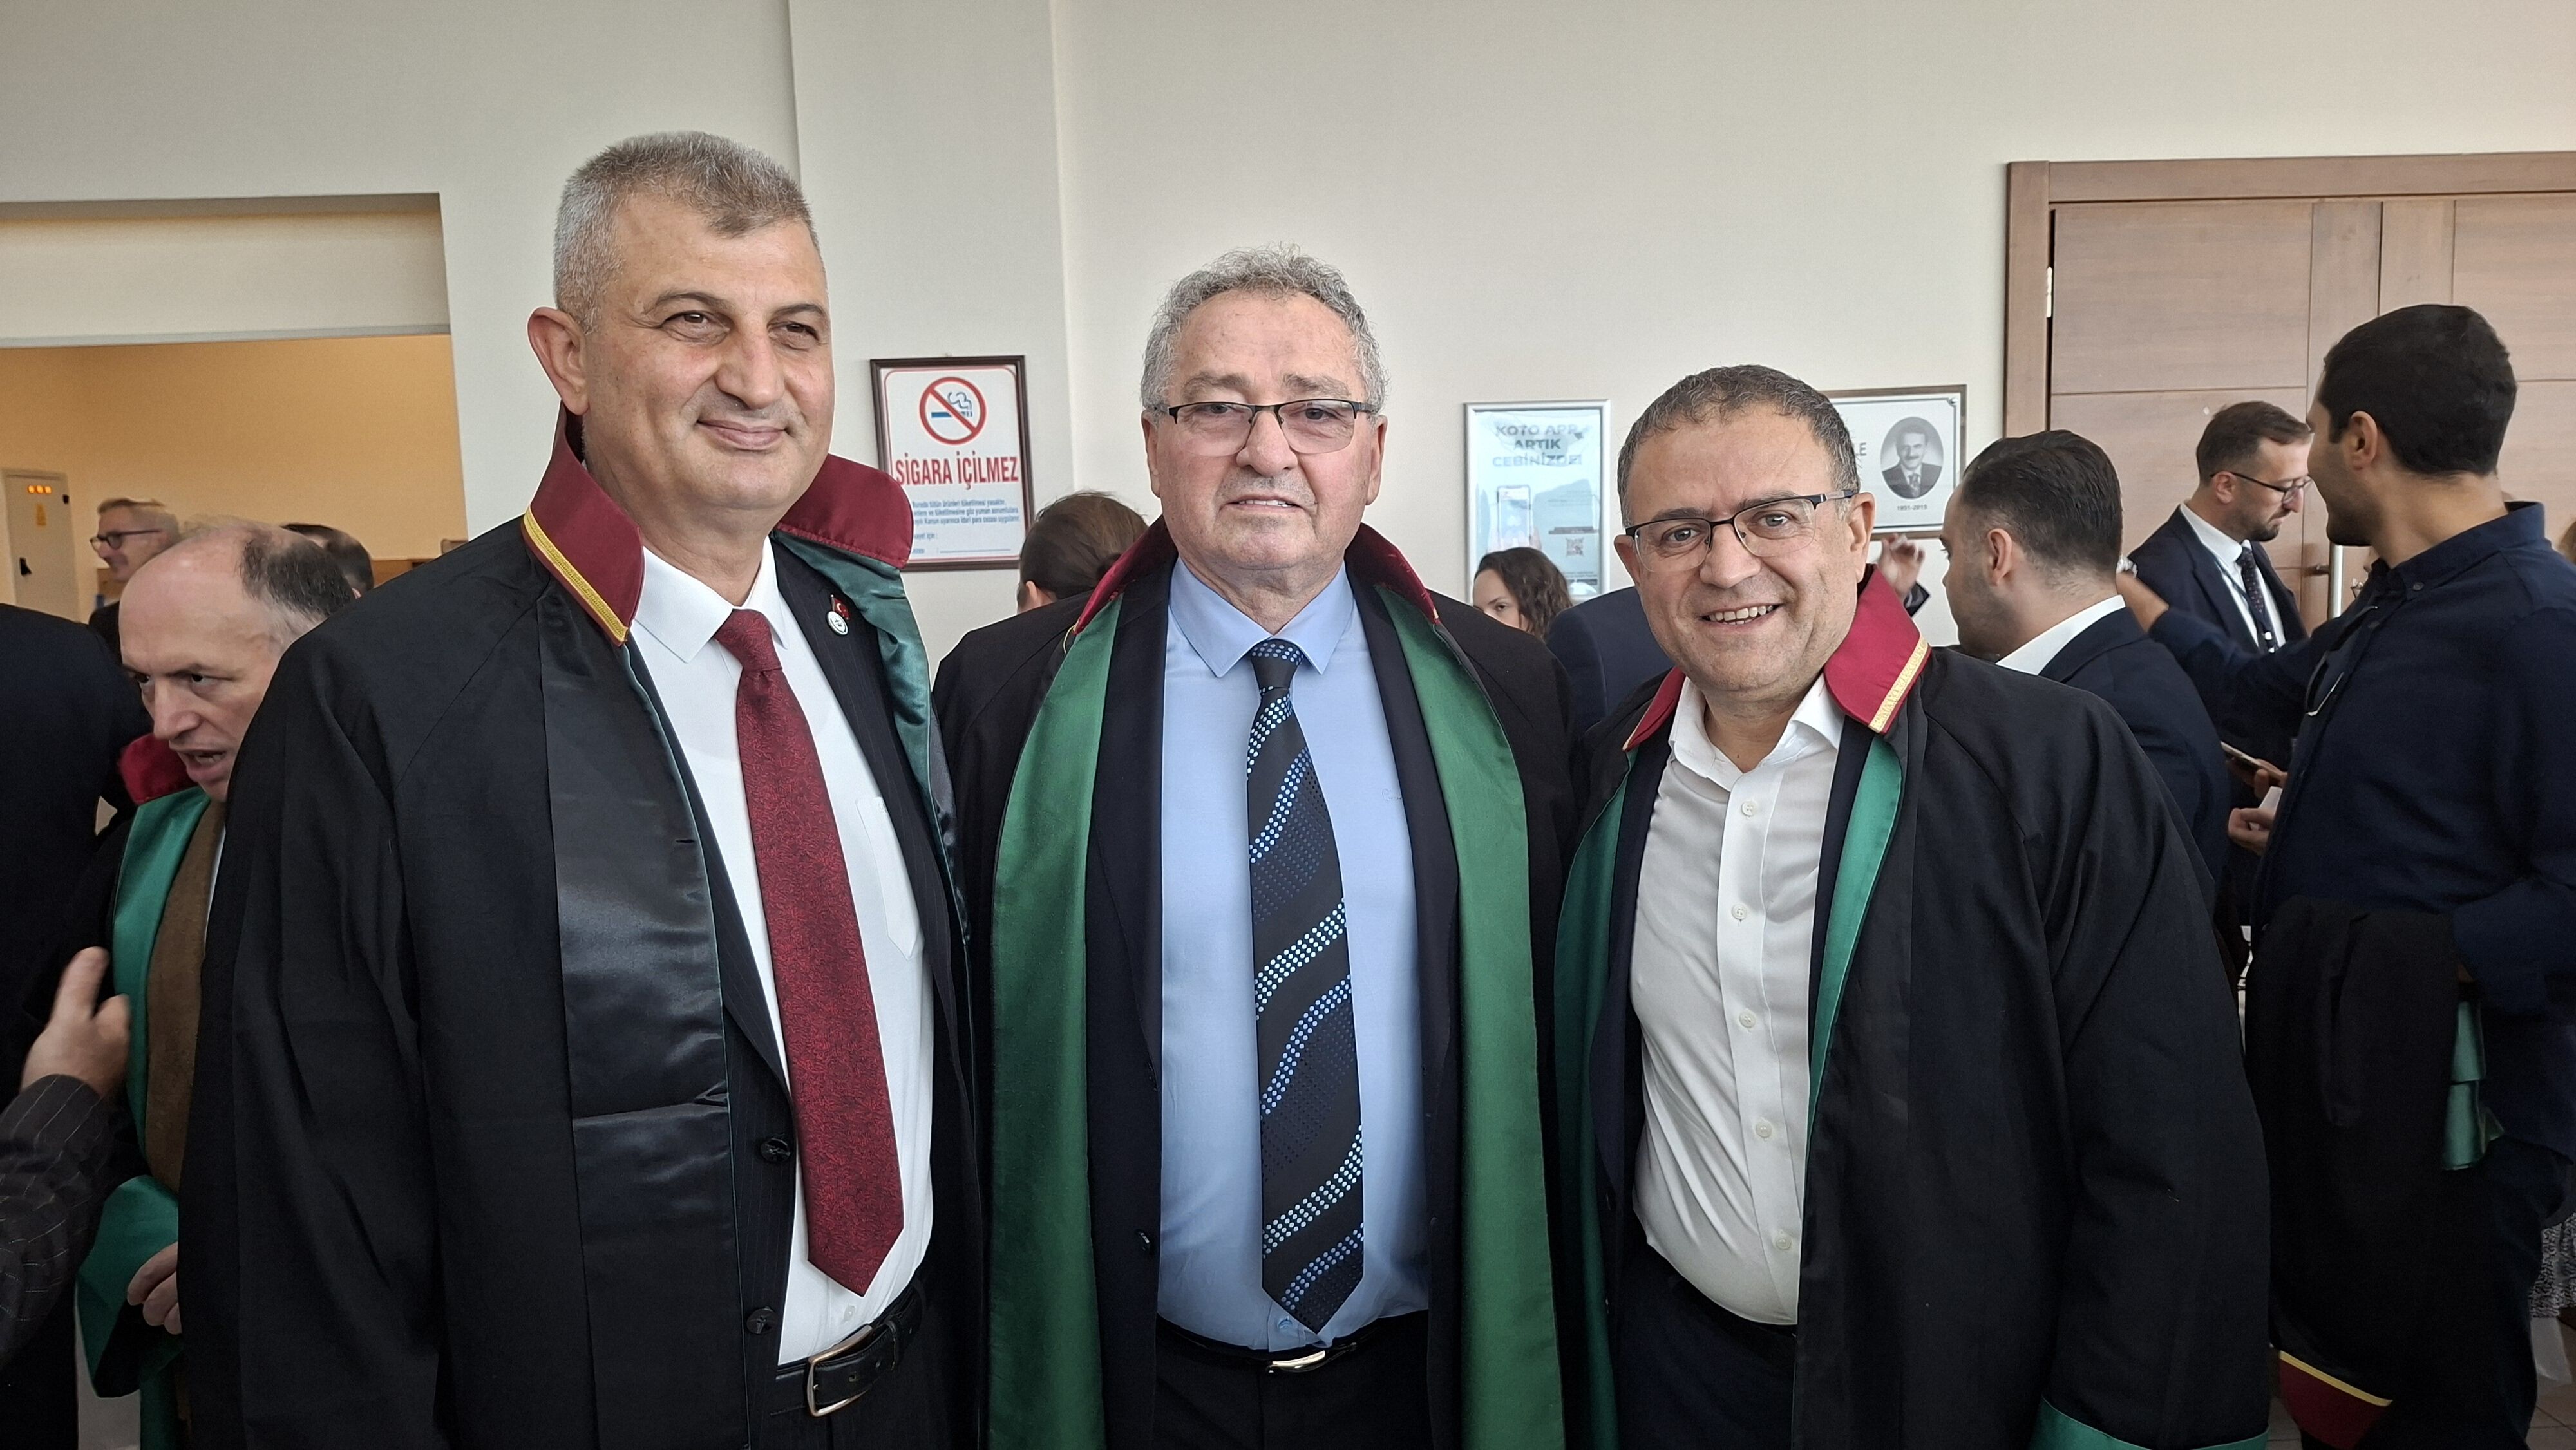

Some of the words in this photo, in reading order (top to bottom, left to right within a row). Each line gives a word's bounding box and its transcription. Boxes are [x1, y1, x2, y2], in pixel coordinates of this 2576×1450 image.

[1495, 425, 1539, 436] KOTO
[1514, 439, 1561, 450] ARTIK
[896, 452, 953, 485] SİGARA
[956, 450, 1019, 490] İÇİLMEZ
